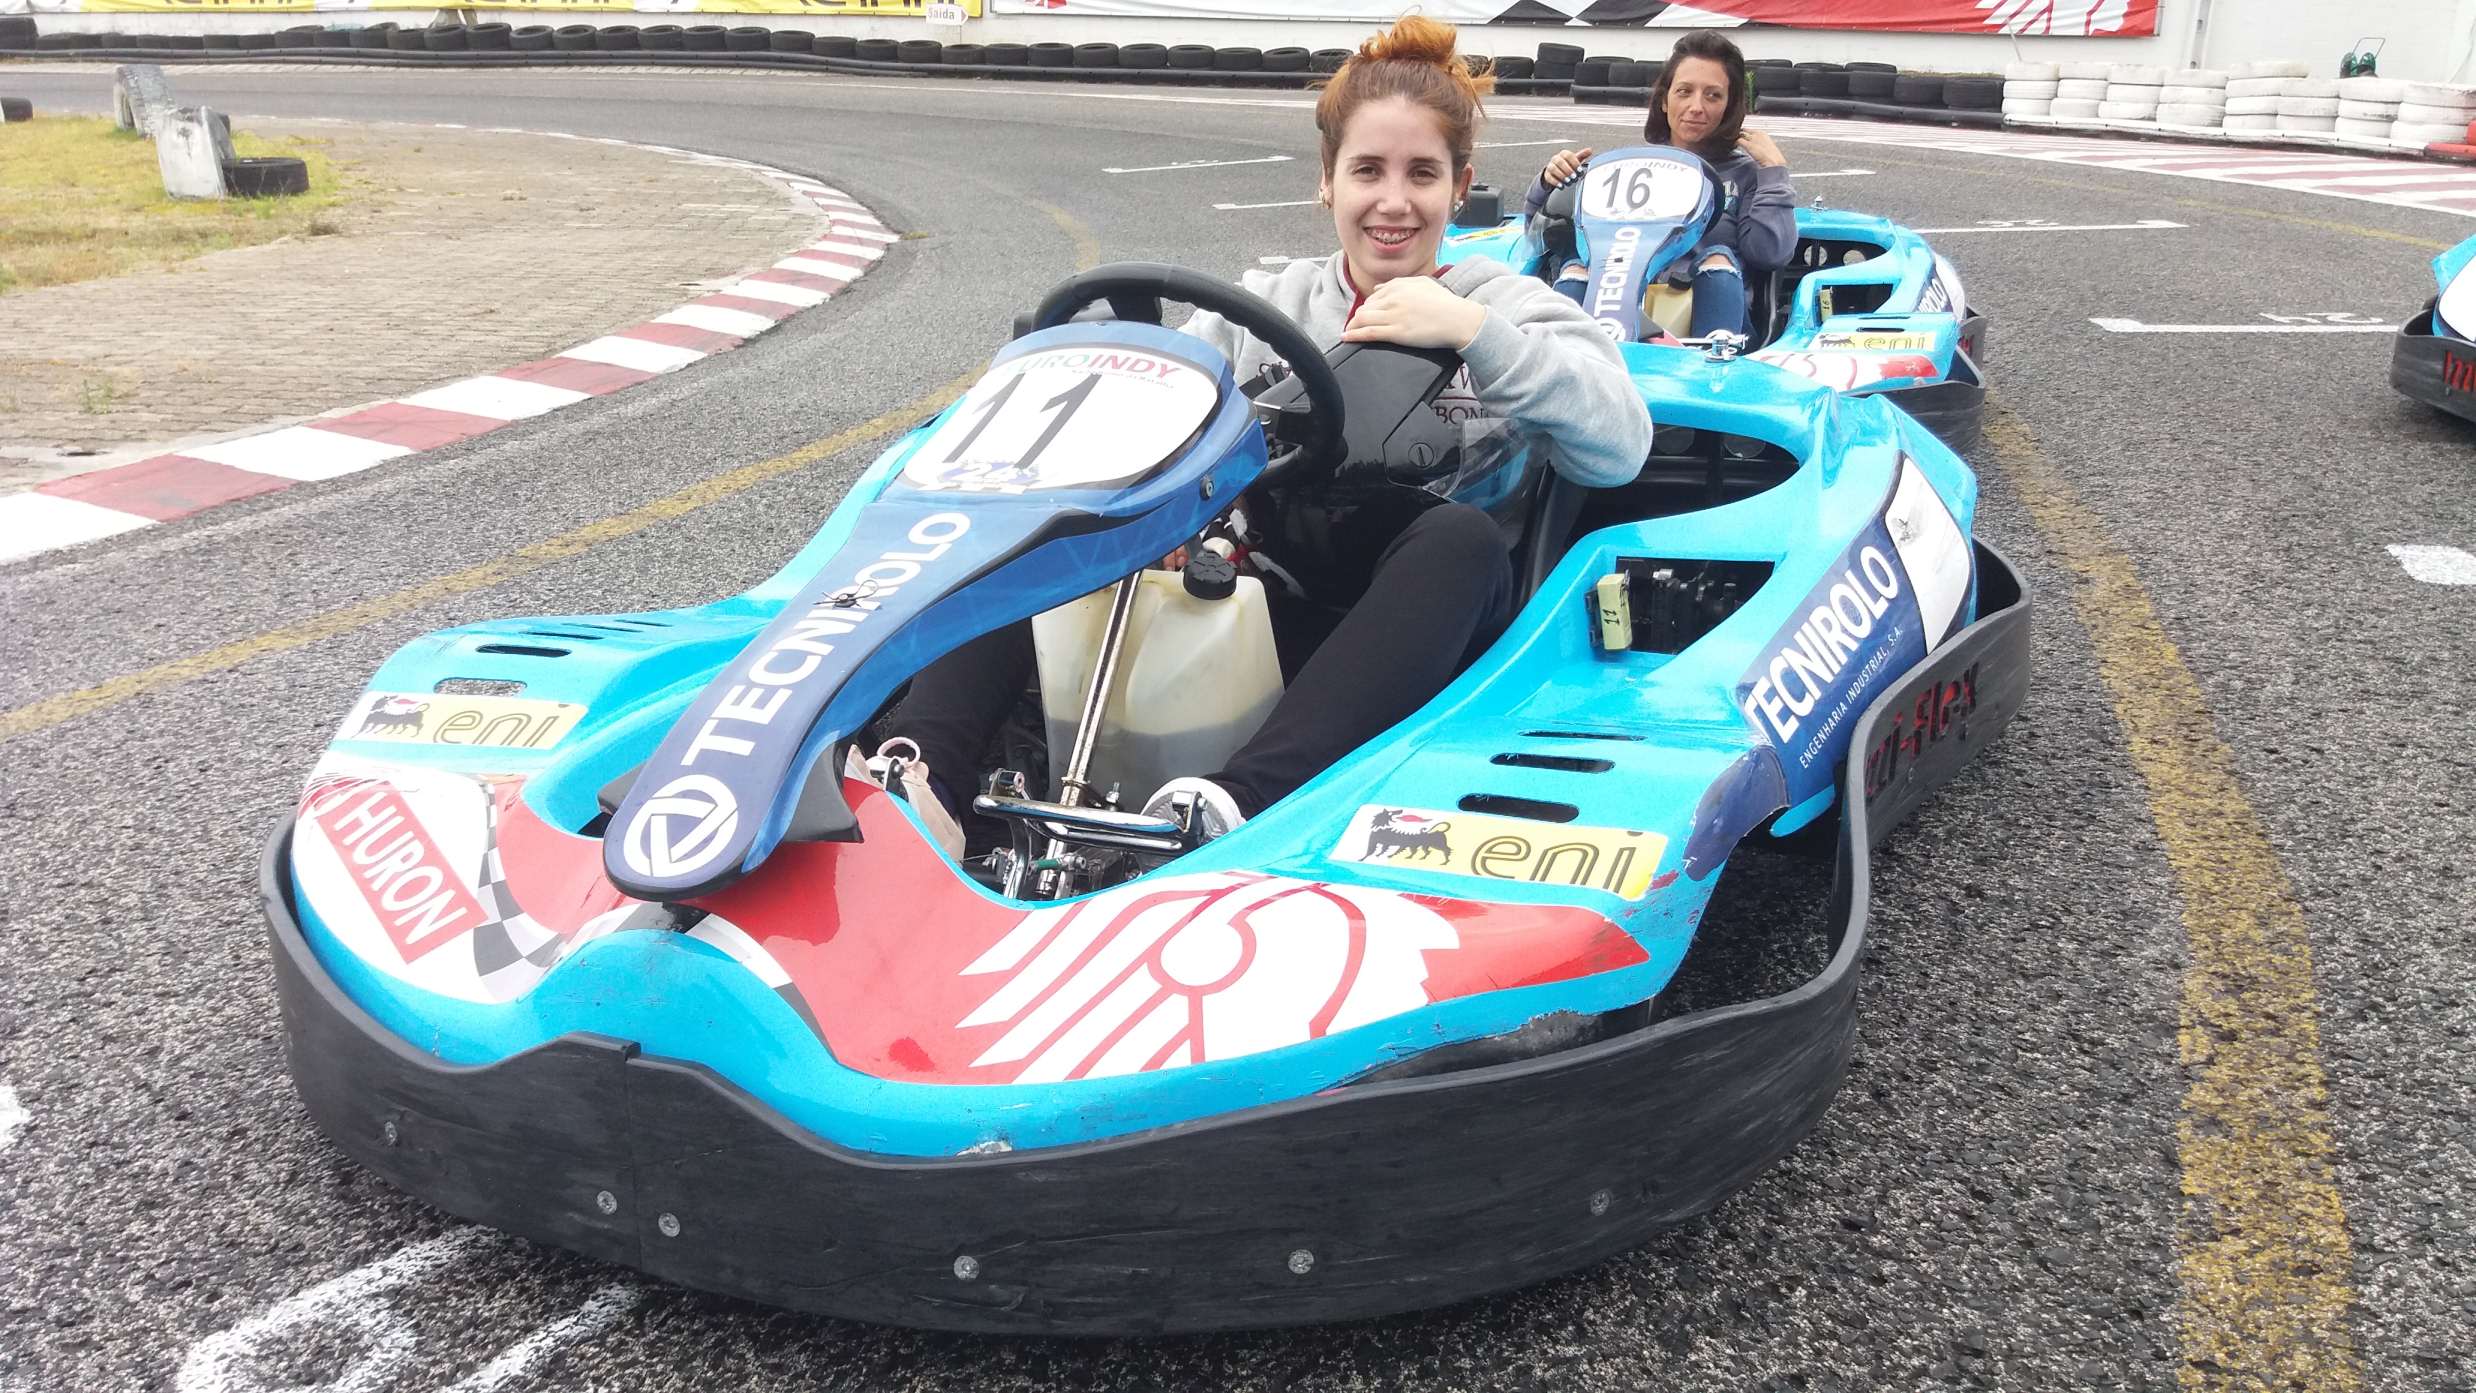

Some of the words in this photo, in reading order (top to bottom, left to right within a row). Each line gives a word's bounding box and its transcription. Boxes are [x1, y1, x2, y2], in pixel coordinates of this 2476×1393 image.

[1602, 167, 1653, 209] 16
[942, 373, 1102, 469] 11
[681, 512, 971, 766] TECNIROLO
[1602, 608, 1620, 626] 11
[1744, 546, 1899, 747] TECNIROLO
[433, 704, 571, 748] eni
[1799, 702, 1848, 769] ENGENHARIA
[333, 791, 468, 944] HURON
[1471, 830, 1644, 895] eni
